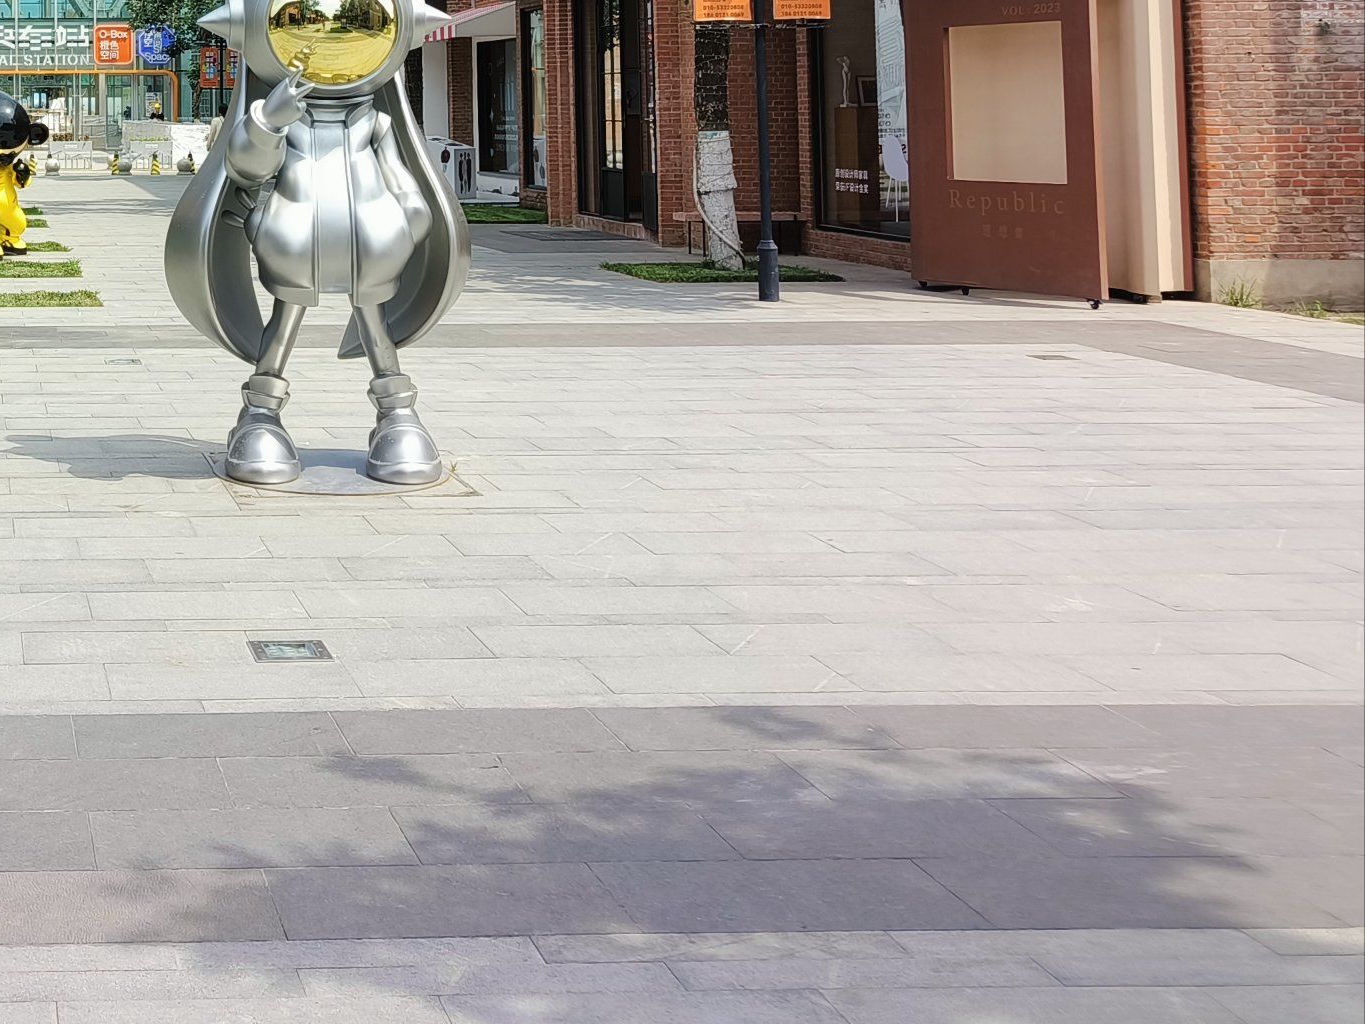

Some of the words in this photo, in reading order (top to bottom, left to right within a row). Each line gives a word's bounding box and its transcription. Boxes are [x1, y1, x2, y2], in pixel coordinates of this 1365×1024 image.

[1034, 2, 1061, 14] 2023
[99, 29, 128, 39] O-Box
[99, 40, 119, 51] 橙色
[23, 54, 90, 67] STATION
[100, 50, 119, 60] 空间
[948, 189, 1065, 215] Republic
